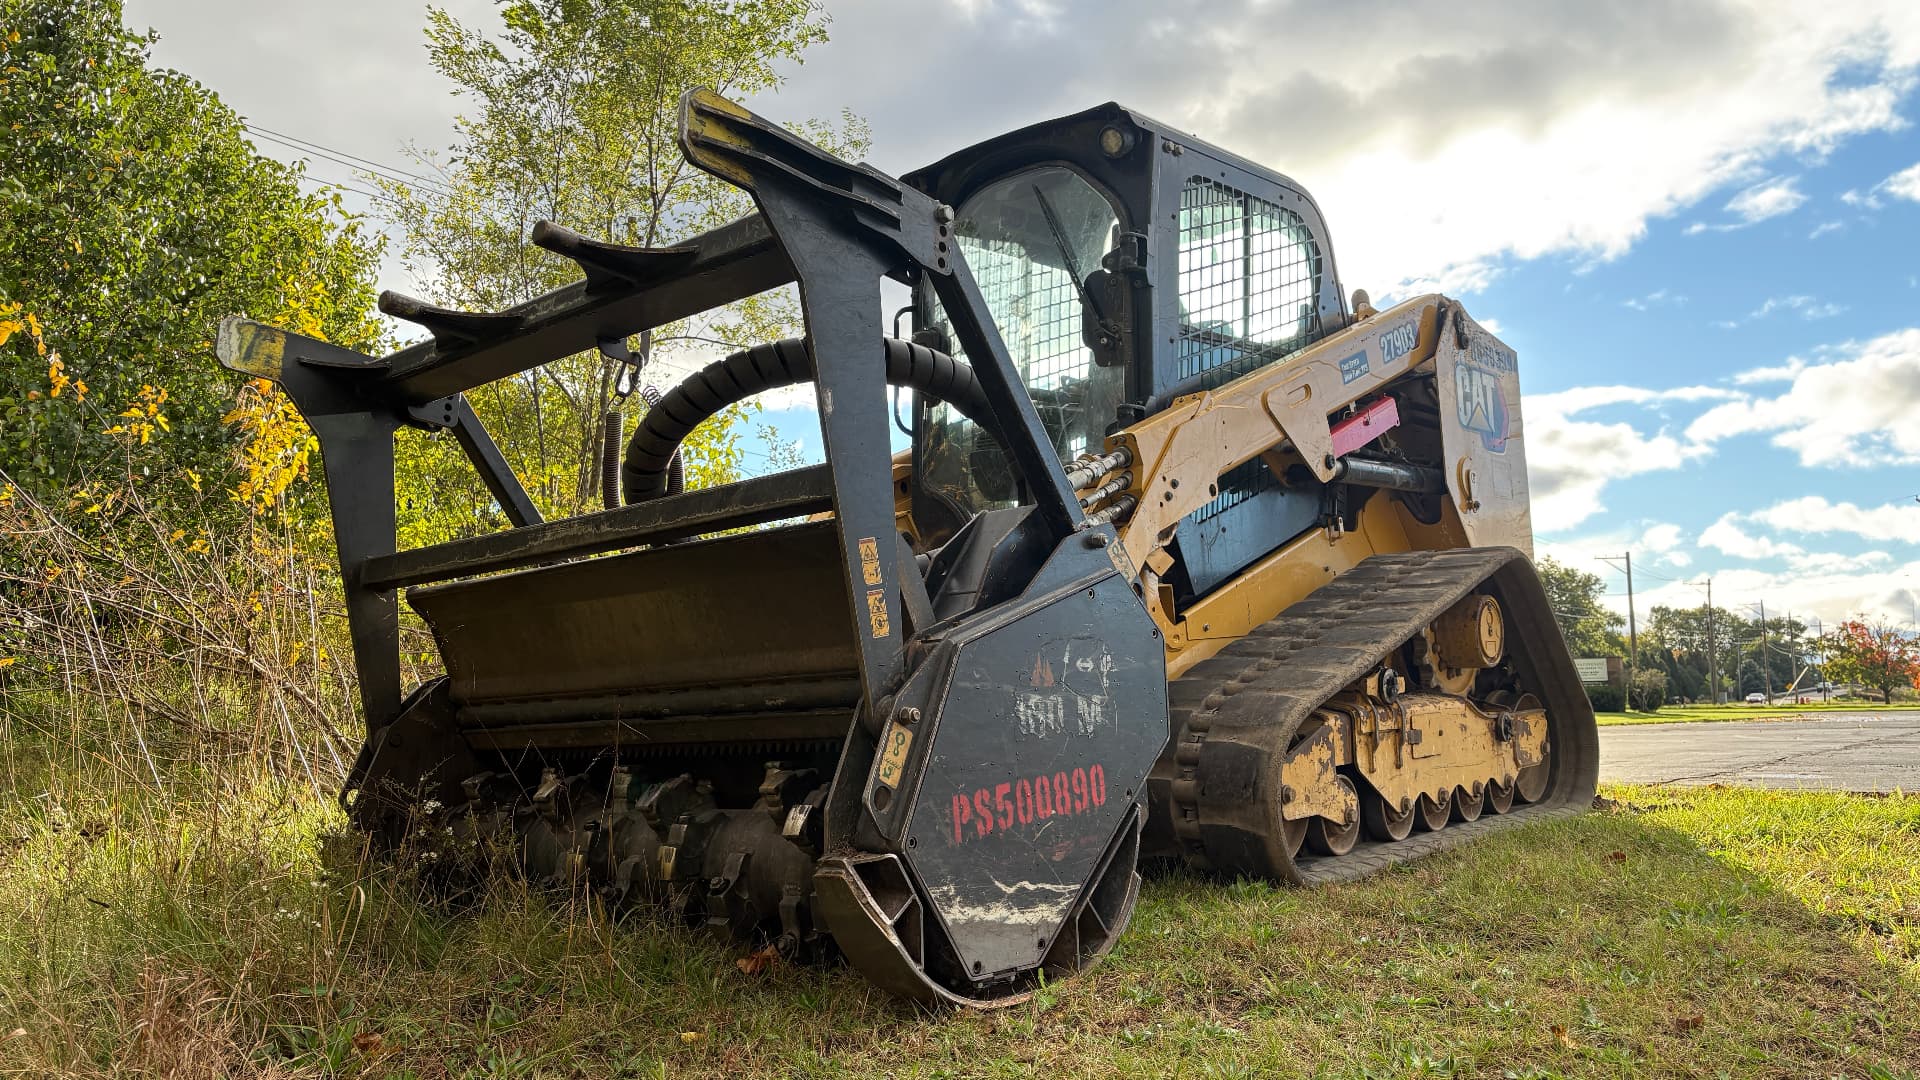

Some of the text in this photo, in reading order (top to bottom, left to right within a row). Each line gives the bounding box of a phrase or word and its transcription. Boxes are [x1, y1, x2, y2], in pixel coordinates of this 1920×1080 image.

[1380, 323, 1416, 362] 279D3
[1456, 364, 1495, 432] CAT
[952, 764, 1106, 844] PS500890
